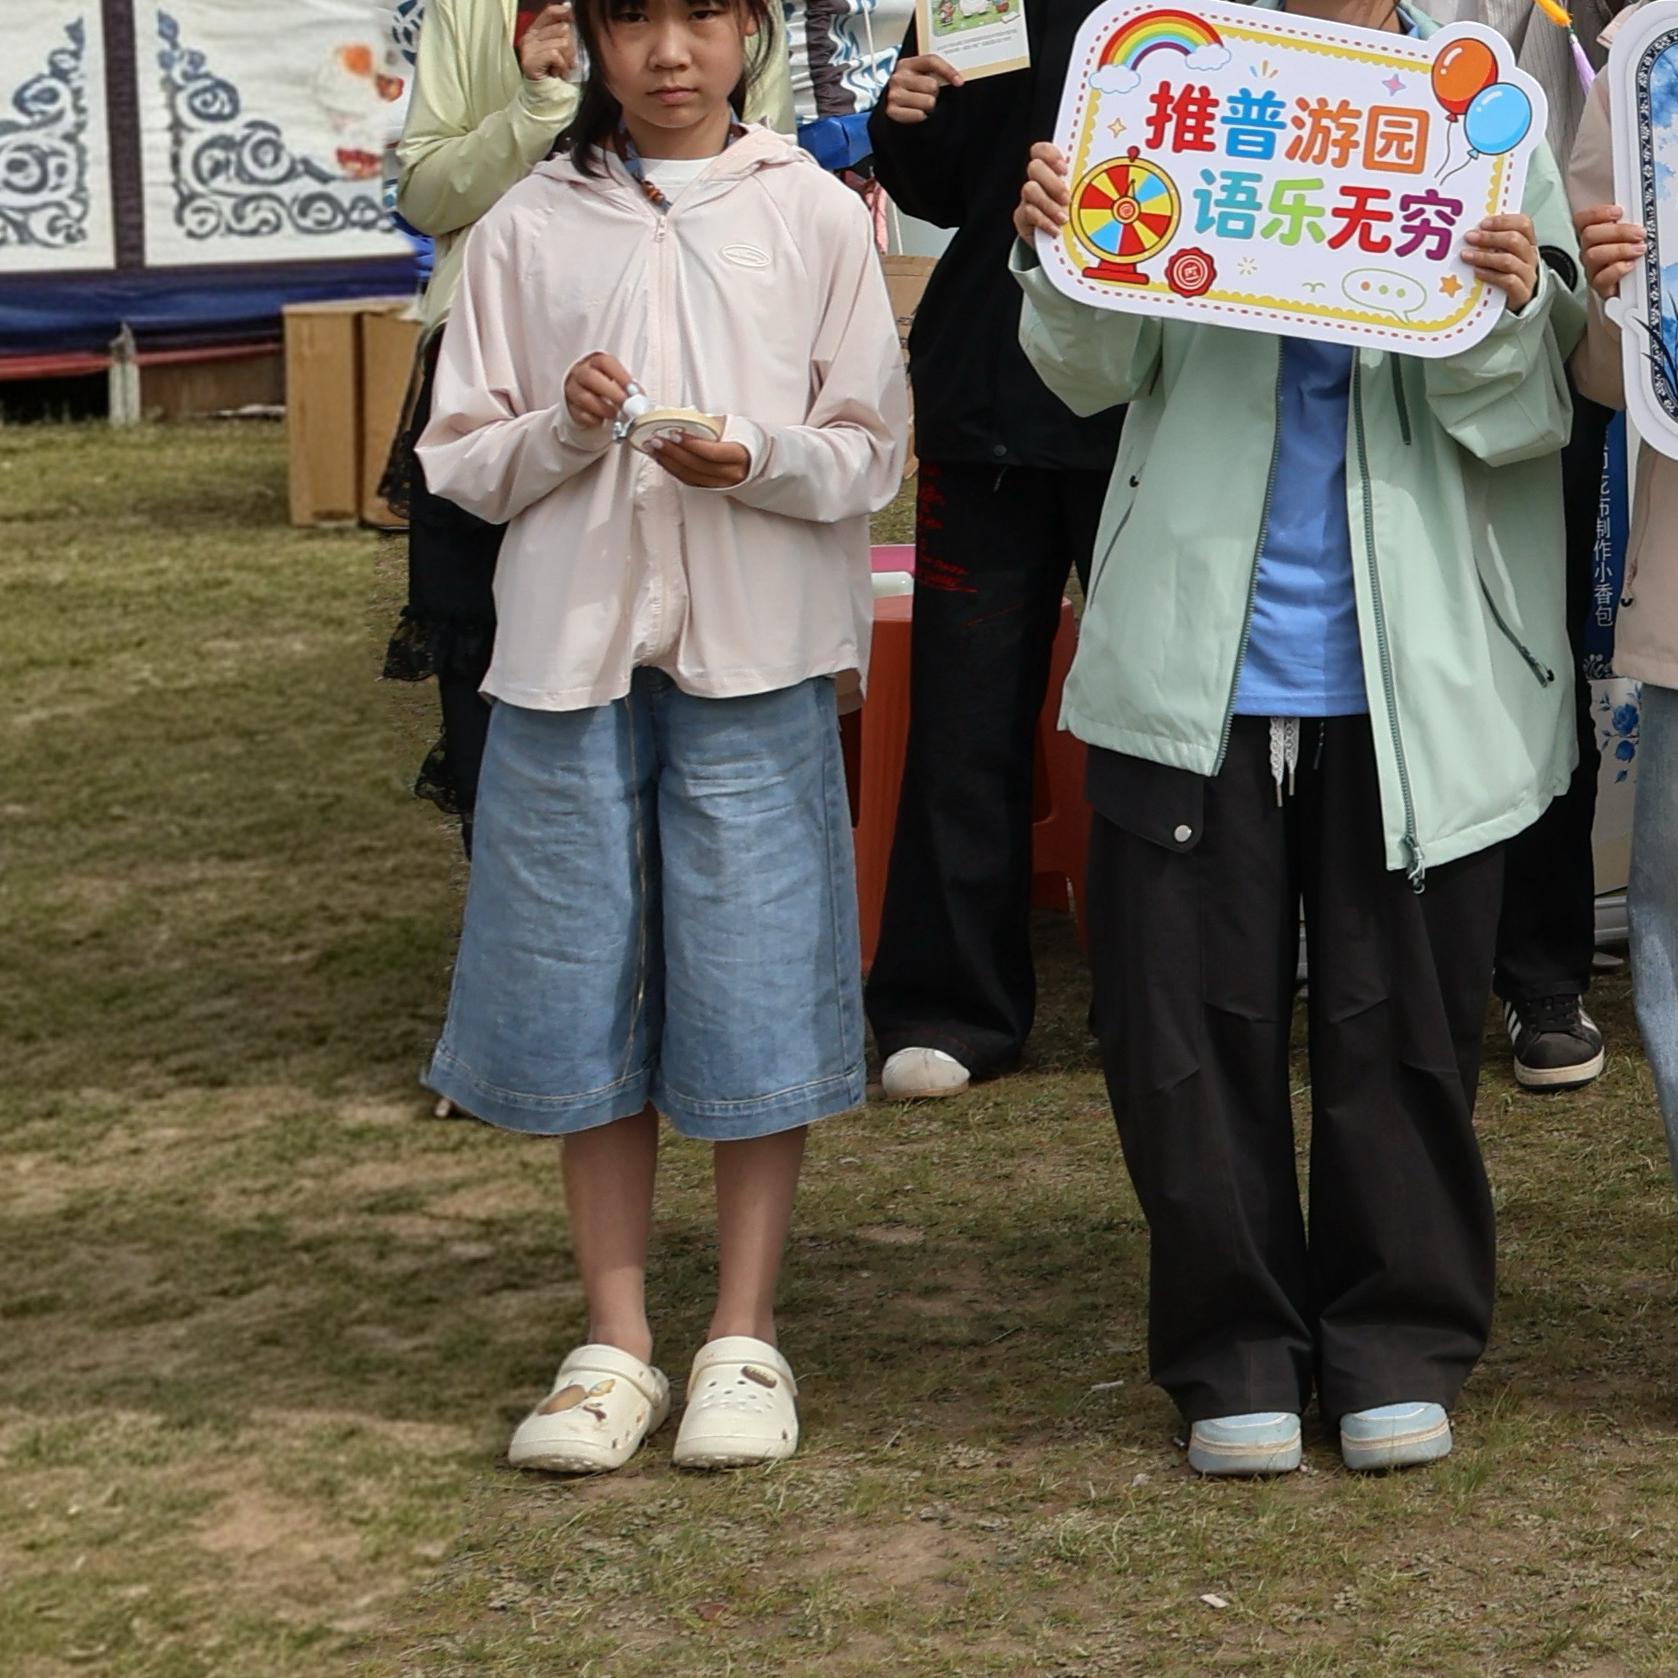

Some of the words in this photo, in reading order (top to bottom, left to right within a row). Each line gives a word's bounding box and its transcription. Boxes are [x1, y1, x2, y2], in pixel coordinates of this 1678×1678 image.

[1145, 79, 1431, 176] 推普游园
[1192, 168, 1464, 262] 语乐无穷
